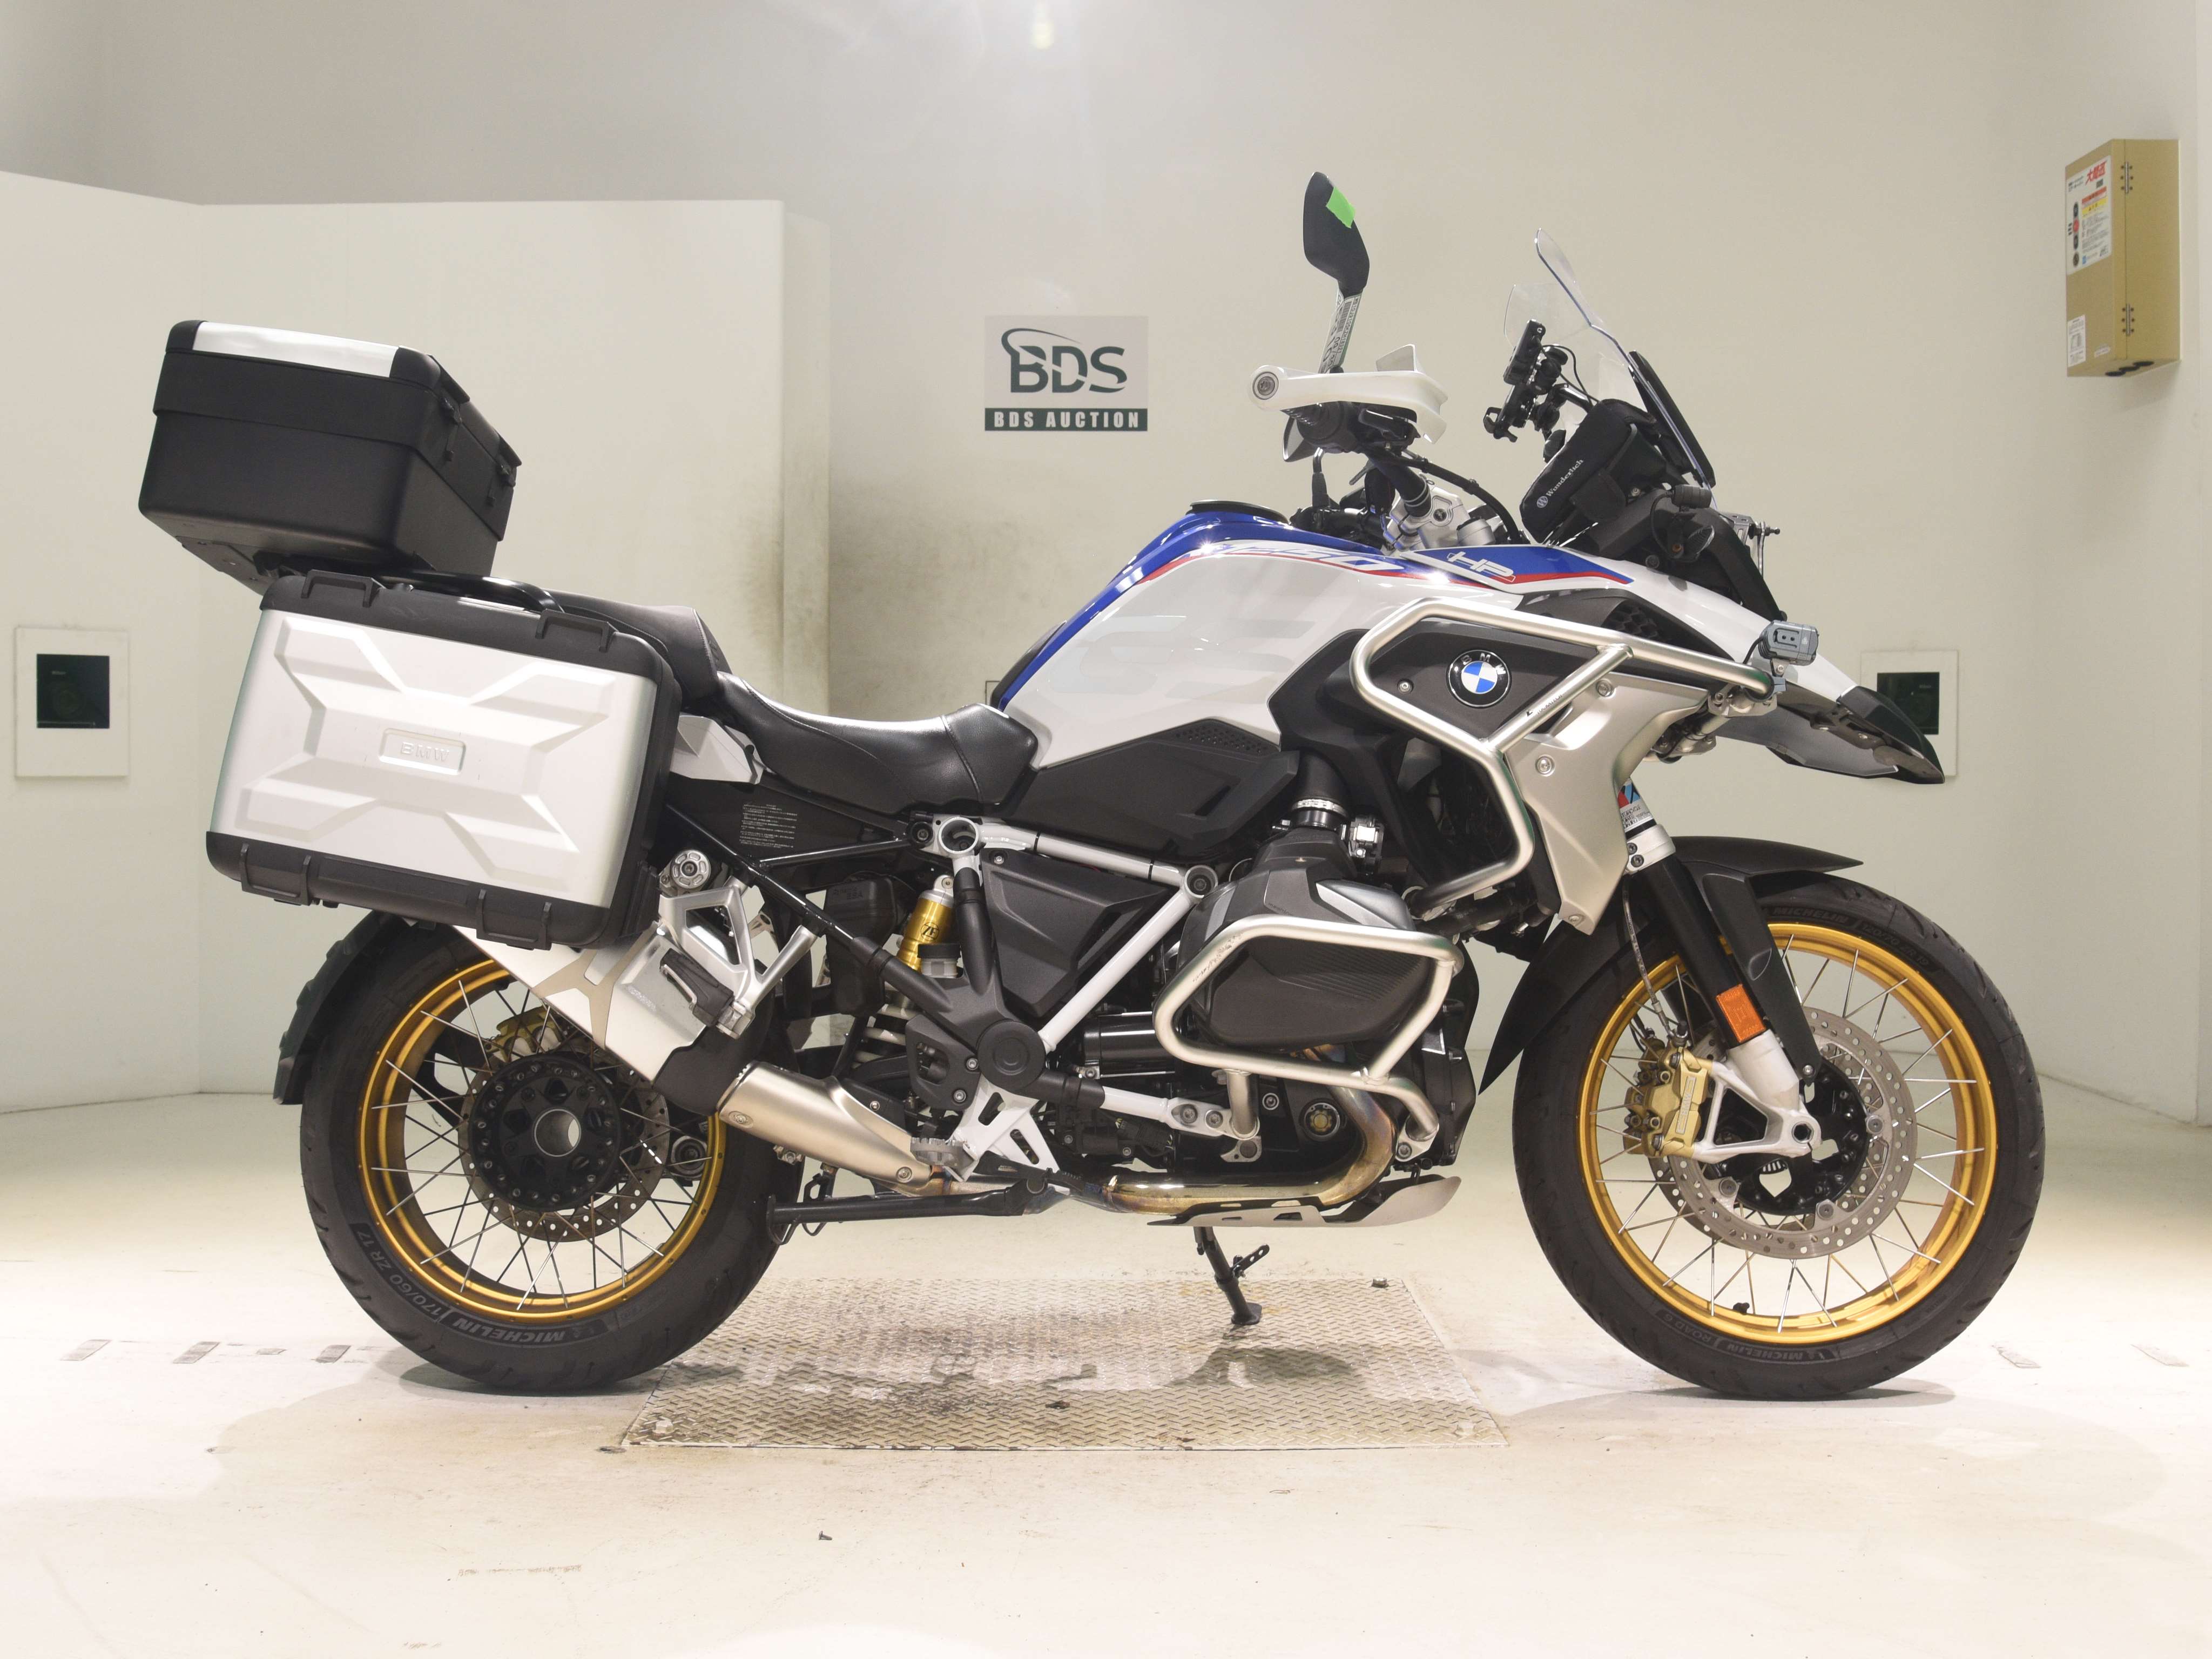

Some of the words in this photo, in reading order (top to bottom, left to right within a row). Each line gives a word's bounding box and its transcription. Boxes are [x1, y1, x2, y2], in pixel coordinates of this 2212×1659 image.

[1001, 328, 1128, 393] BDS
[994, 412, 1034, 428] BDS
[1046, 412, 1139, 428] AUCTION
[1546, 460, 1584, 497] Wunderlich
[1447, 551, 1514, 577] HP
[1460, 652, 1507, 675] BMW
[401, 741, 450, 761] BMW
[357, 1231, 374, 1247] 17
[370, 1251, 392, 1271] ZR
[389, 1274, 442, 1316] 170/60
[453, 1318, 565, 1343] MICHELIN
[1727, 1343, 1804, 1361] MICHELIN
